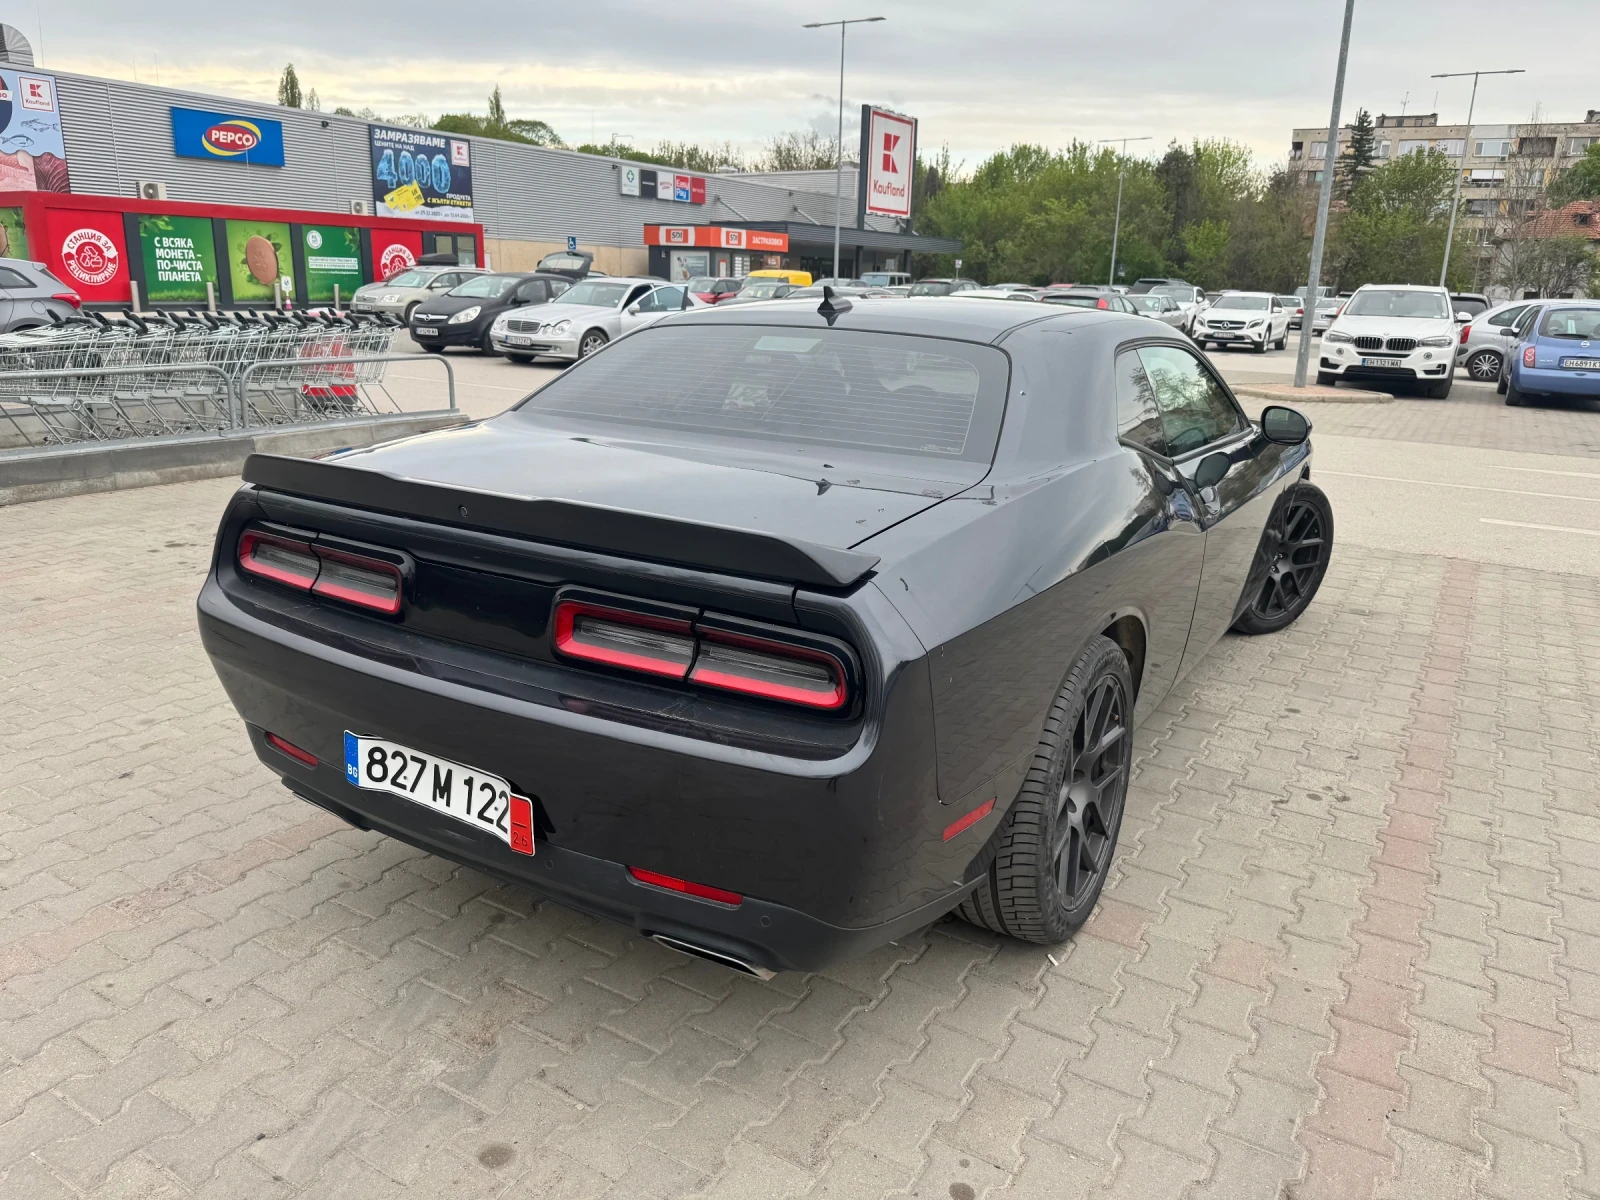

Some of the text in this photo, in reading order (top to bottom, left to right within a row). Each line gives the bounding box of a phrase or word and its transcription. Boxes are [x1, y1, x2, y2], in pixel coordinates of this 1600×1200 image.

[25, 99, 50, 107] Kaufland
[211, 130, 253, 146] PEPCO
[374, 129, 446, 148] ЗАМРАЗЯВАМЕ
[374, 140, 395, 149] ЦЕНИТЕ
[376, 149, 452, 194] 4000
[676, 179, 689, 189] Easy
[873, 179, 905, 198] Kaufland
[446, 193, 471, 201] ПРОДУКТА
[676, 188, 687, 199] Pay
[431, 197, 450, 205] ЖЪЛТИ
[450, 199, 472, 207] ЕТИКЕТИ
[67, 231, 112, 252] СТАНЦИЯ ЗА
[154, 237, 194, 248] С ВСЯКА
[752, 235, 783, 246] ЗАСТРАХОВКИ
[156, 248, 195, 259] МОНЕТА
[384, 246, 412, 263] СТАНЦИЯ ЗА
[67, 259, 116, 283] РЕЦИКЛИРАНЕ
[157, 260, 203, 271] ПО-ЧИСТА
[158, 271, 202, 282] ПЛАНЕТА
[347, 763, 358, 778] BG
[366, 746, 510, 835] 827 M 122
[513, 831, 528, 847] 26
